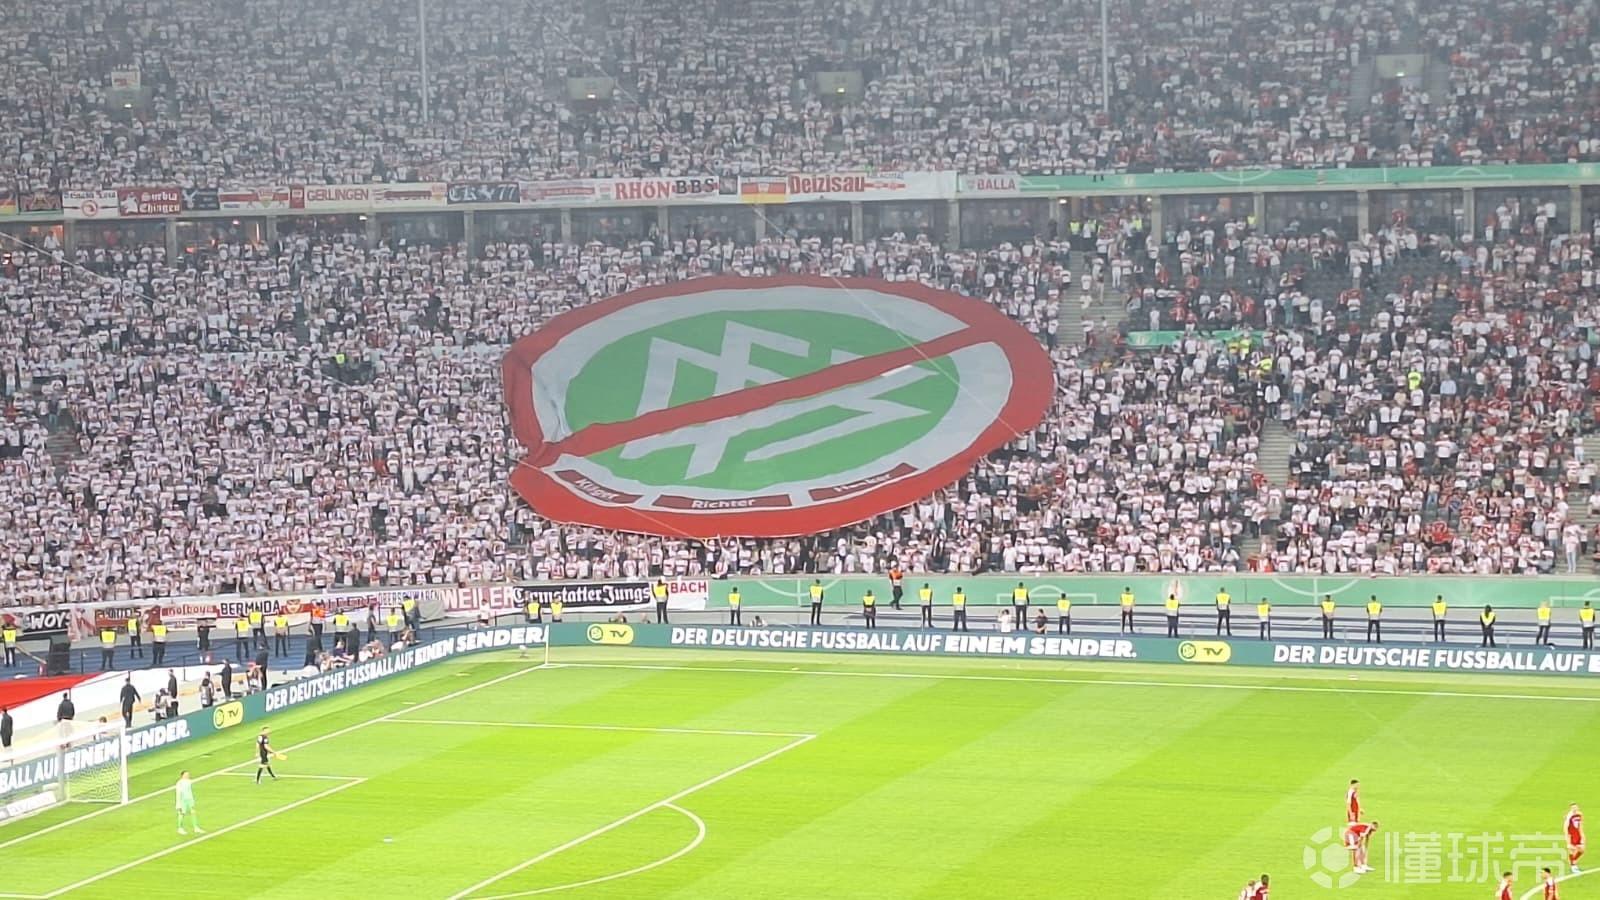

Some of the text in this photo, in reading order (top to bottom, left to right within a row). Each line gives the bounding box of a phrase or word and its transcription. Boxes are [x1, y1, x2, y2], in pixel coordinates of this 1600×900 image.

[615, 182, 671, 200] RHÖN
[788, 174, 864, 194] Deizisau
[977, 179, 1016, 190] BALLA
[306, 188, 369, 201] GERLINGEN
[691, 498, 755, 510] Richter
[441, 587, 514, 608] WEILER
[602, 585, 650, 604] Jungs
[610, 630, 627, 638] TV
[671, 627, 1137, 658] DER DEUTSCHE FUSSBALL AUF EINEM SENDER.
[1203, 647, 1223, 656] TV
[1273, 644, 1315, 663] DER
[1320, 646, 1429, 667] DEUTSCHE
[1434, 648, 1537, 671] FUSSBALL
[1540, 651, 1584, 672] AUF
[265, 688, 287, 712] DER
[289, 671, 345, 703] DEUTSCHE
[345, 656, 393, 684] FUSSBALL
[394, 650, 415, 672] AUF
[415, 637, 454, 664] EINEM
[228, 709, 239, 718] TV
[64, 741, 120, 773] EINEM
